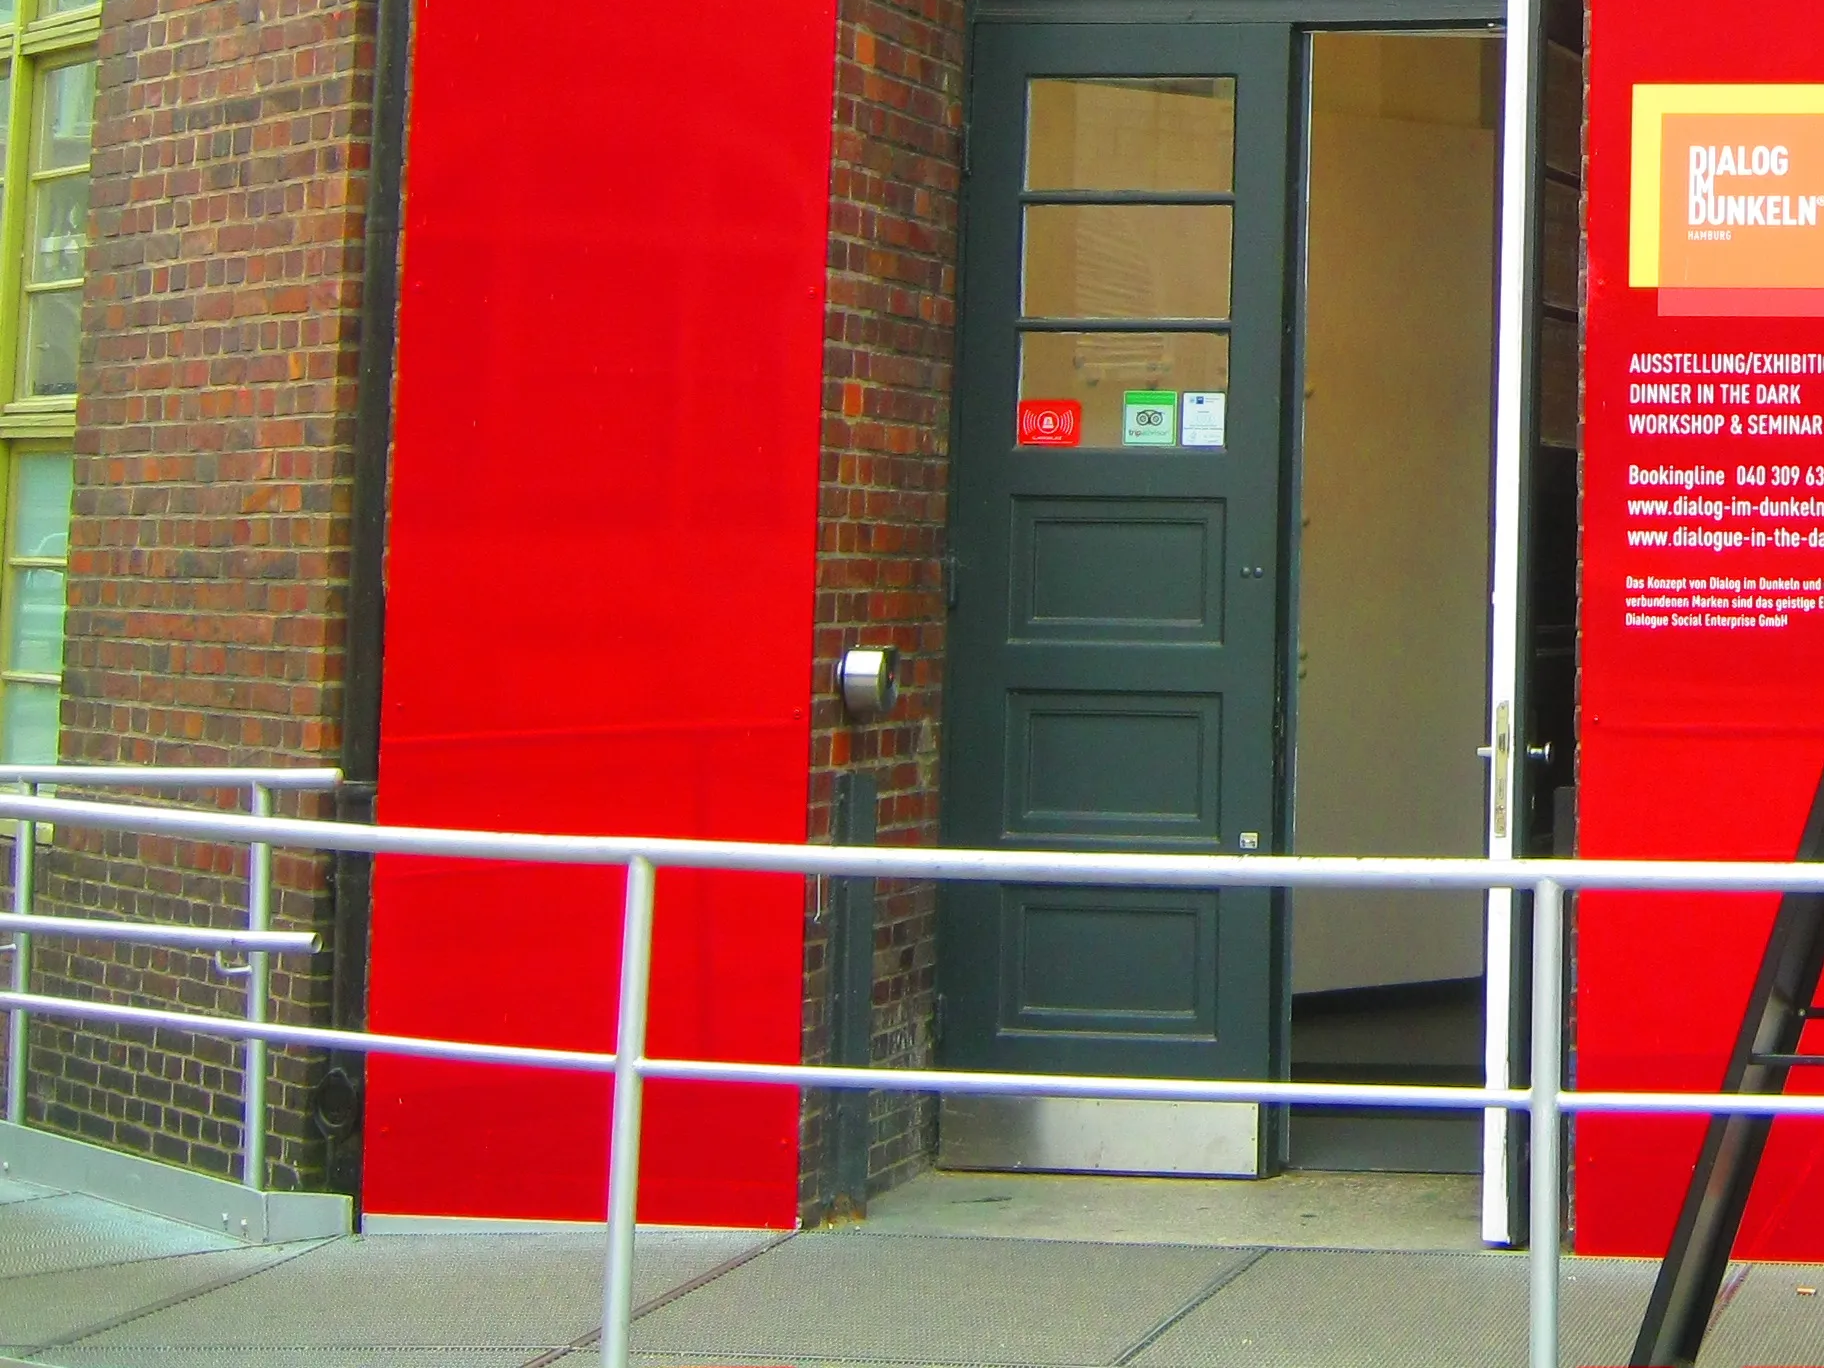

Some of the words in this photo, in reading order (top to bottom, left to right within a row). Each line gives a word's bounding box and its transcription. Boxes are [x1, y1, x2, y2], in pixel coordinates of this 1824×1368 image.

[1689, 145, 1788, 176] DIALOG
[1689, 173, 1714, 197] IM
[1688, 231, 1731, 241] HAMBURG
[1629, 384, 1691, 404] DINNER
[1698, 384, 1714, 404] IN
[1720, 384, 1750, 404] THE
[1756, 384, 1801, 404] DARK
[1629, 414, 1724, 434] WORKSHOP
[1730, 415, 1742, 434] &
[1747, 415, 1823, 435] SEMINAR
[1629, 465, 1724, 490] Bookingline
[1737, 466, 1765, 485] 040
[1771, 466, 1800, 486] 309
[1626, 575, 1645, 590] Das
[1647, 576, 1687, 592] Konzept
[1689, 579, 1707, 590] von
[1709, 576, 1741, 592] Dialog
[1744, 577, 1756, 590] im
[1759, 577, 1800, 590] Dunkeln
[1803, 577, 1821, 590] und
[1626, 594, 1690, 608] verbundenen
[1692, 595, 1729, 608] Marken
[1732, 595, 1753, 609] sind
[1756, 595, 1773, 609] das
[1776, 595, 1816, 612] geistige
[1626, 613, 1669, 628] Dialogue
[1671, 613, 1702, 627] Social
[1705, 614, 1756, 629] Enterprise
[1759, 614, 1788, 627] GmbH
